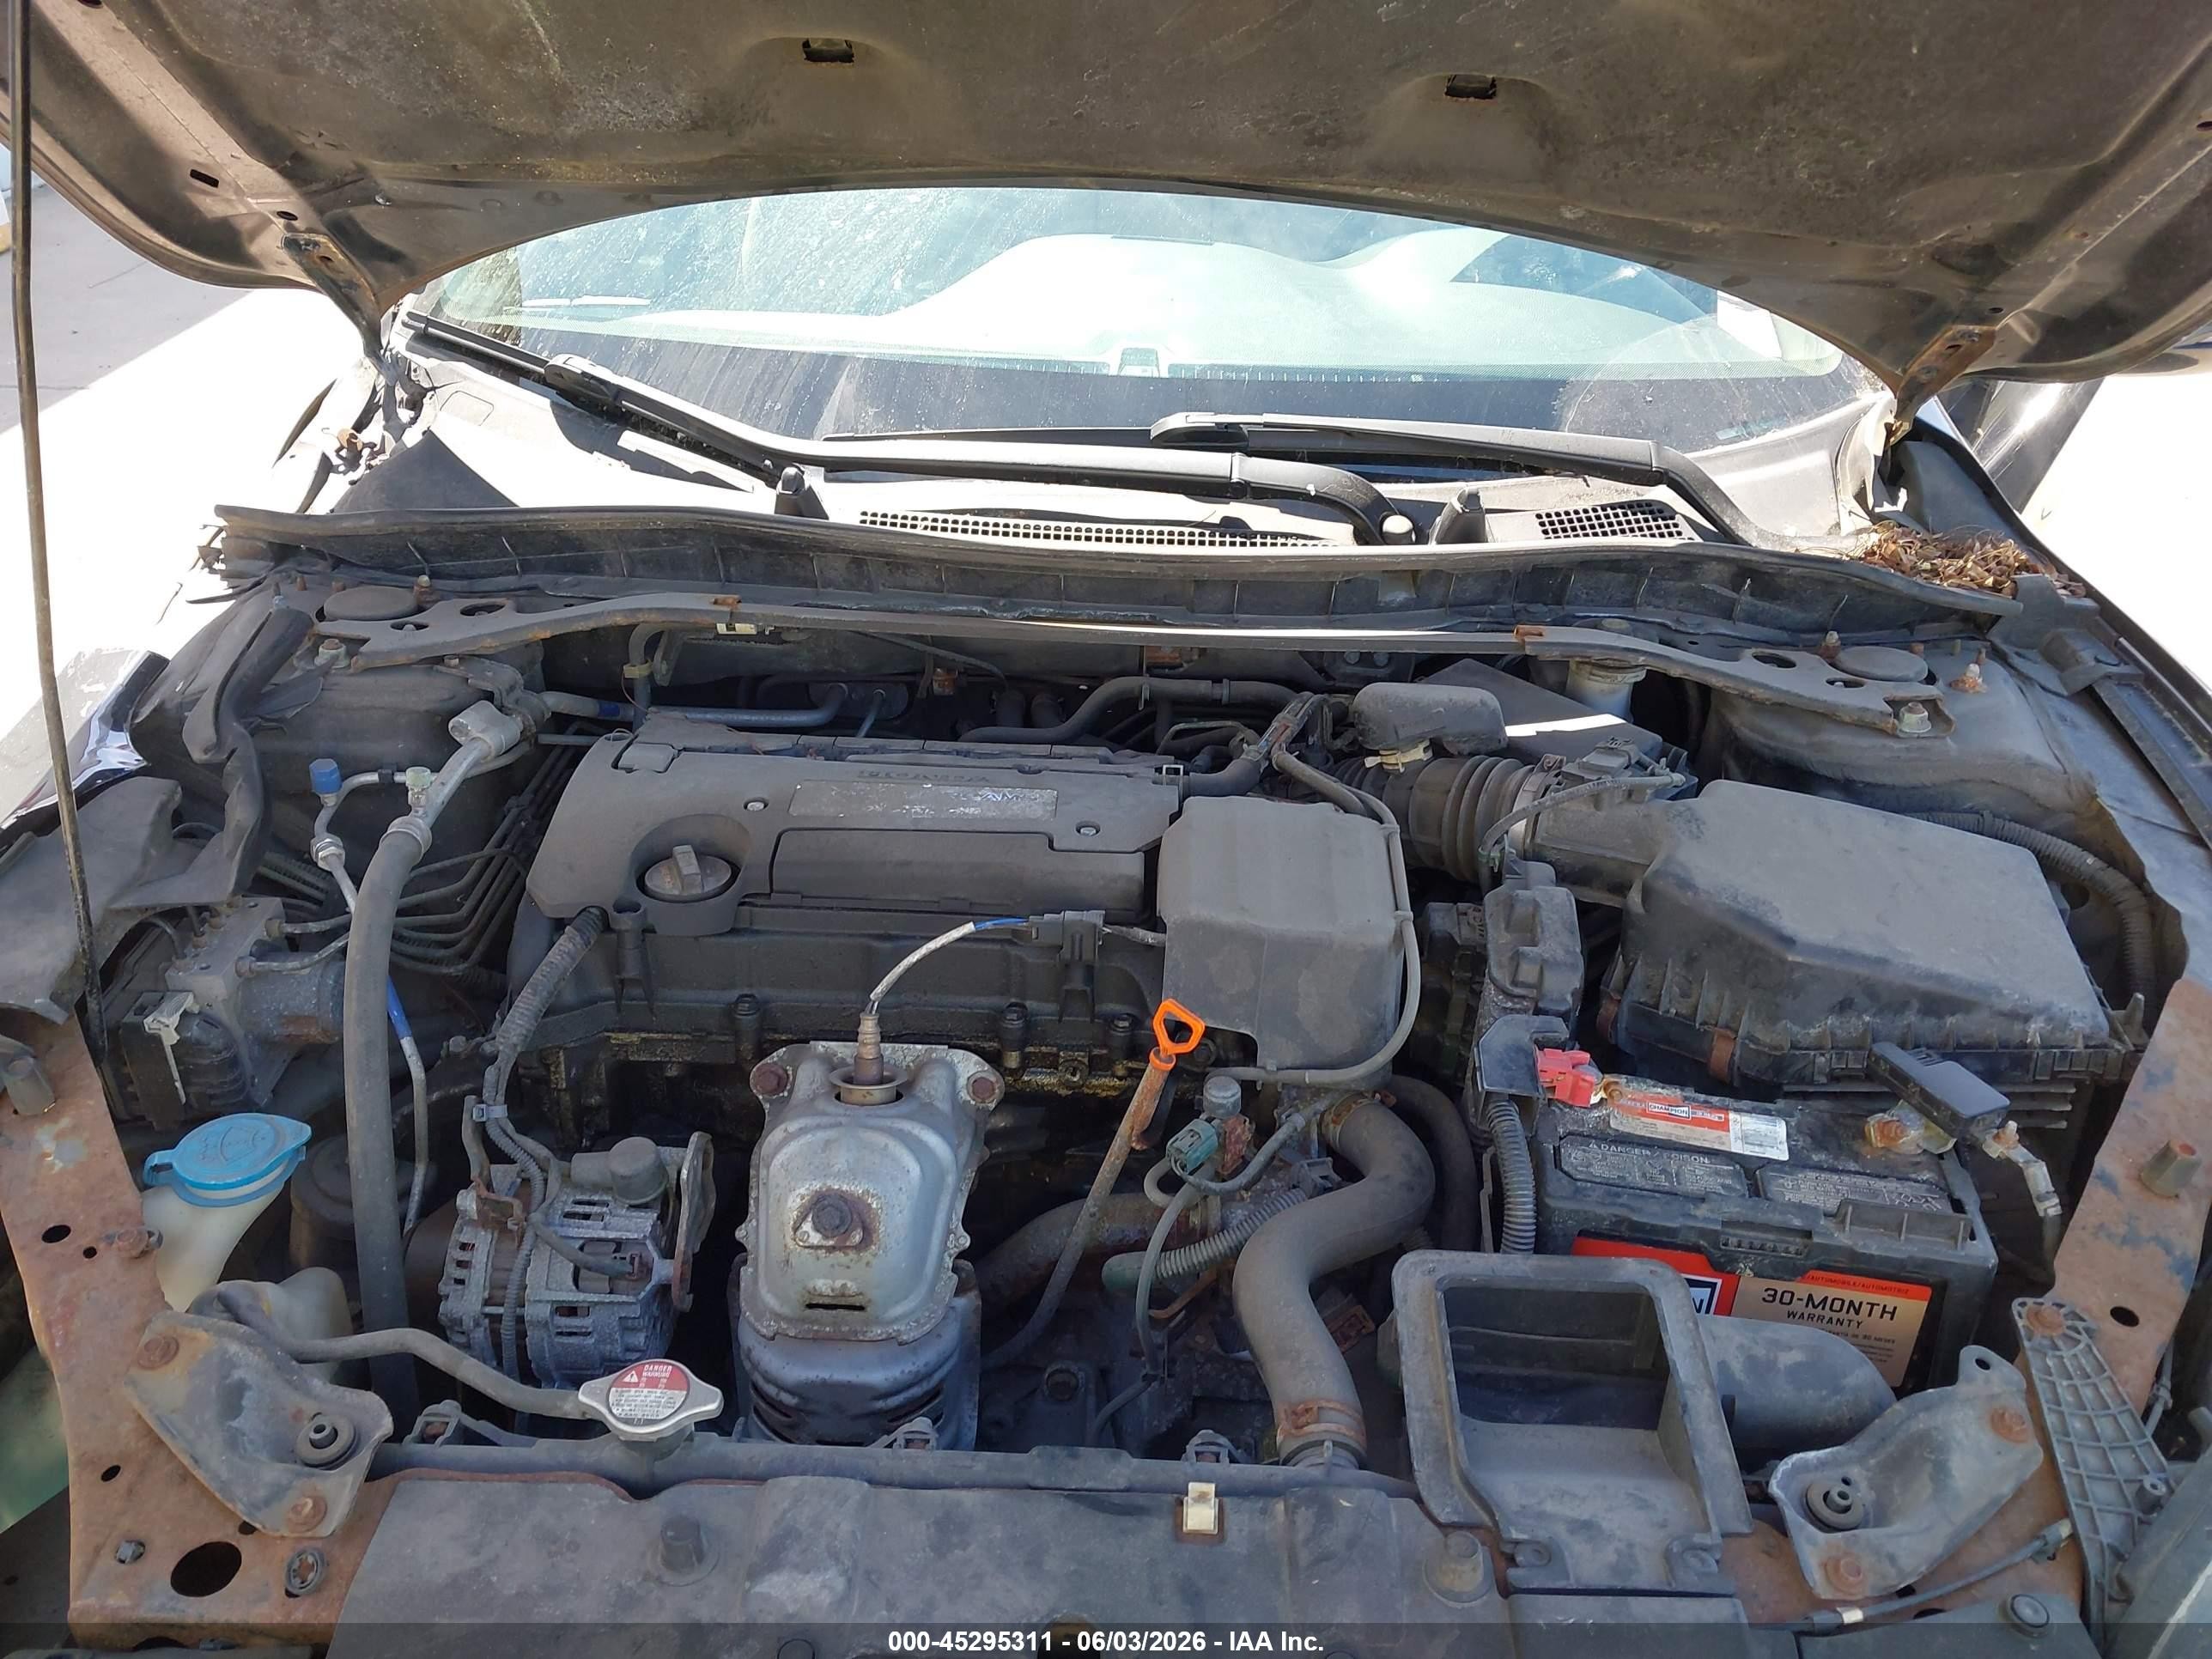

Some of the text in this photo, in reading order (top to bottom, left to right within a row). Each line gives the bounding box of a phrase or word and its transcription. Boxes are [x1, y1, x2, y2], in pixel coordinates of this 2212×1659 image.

[1649, 1103, 1688, 1117] CHAMPION
[1601, 1143, 1651, 1156] DANGER
[1663, 1152, 1711, 1164] POISON
[1761, 1287, 1898, 1322] 30-MONTH
[1787, 1310, 1864, 1329] WARRANTY
